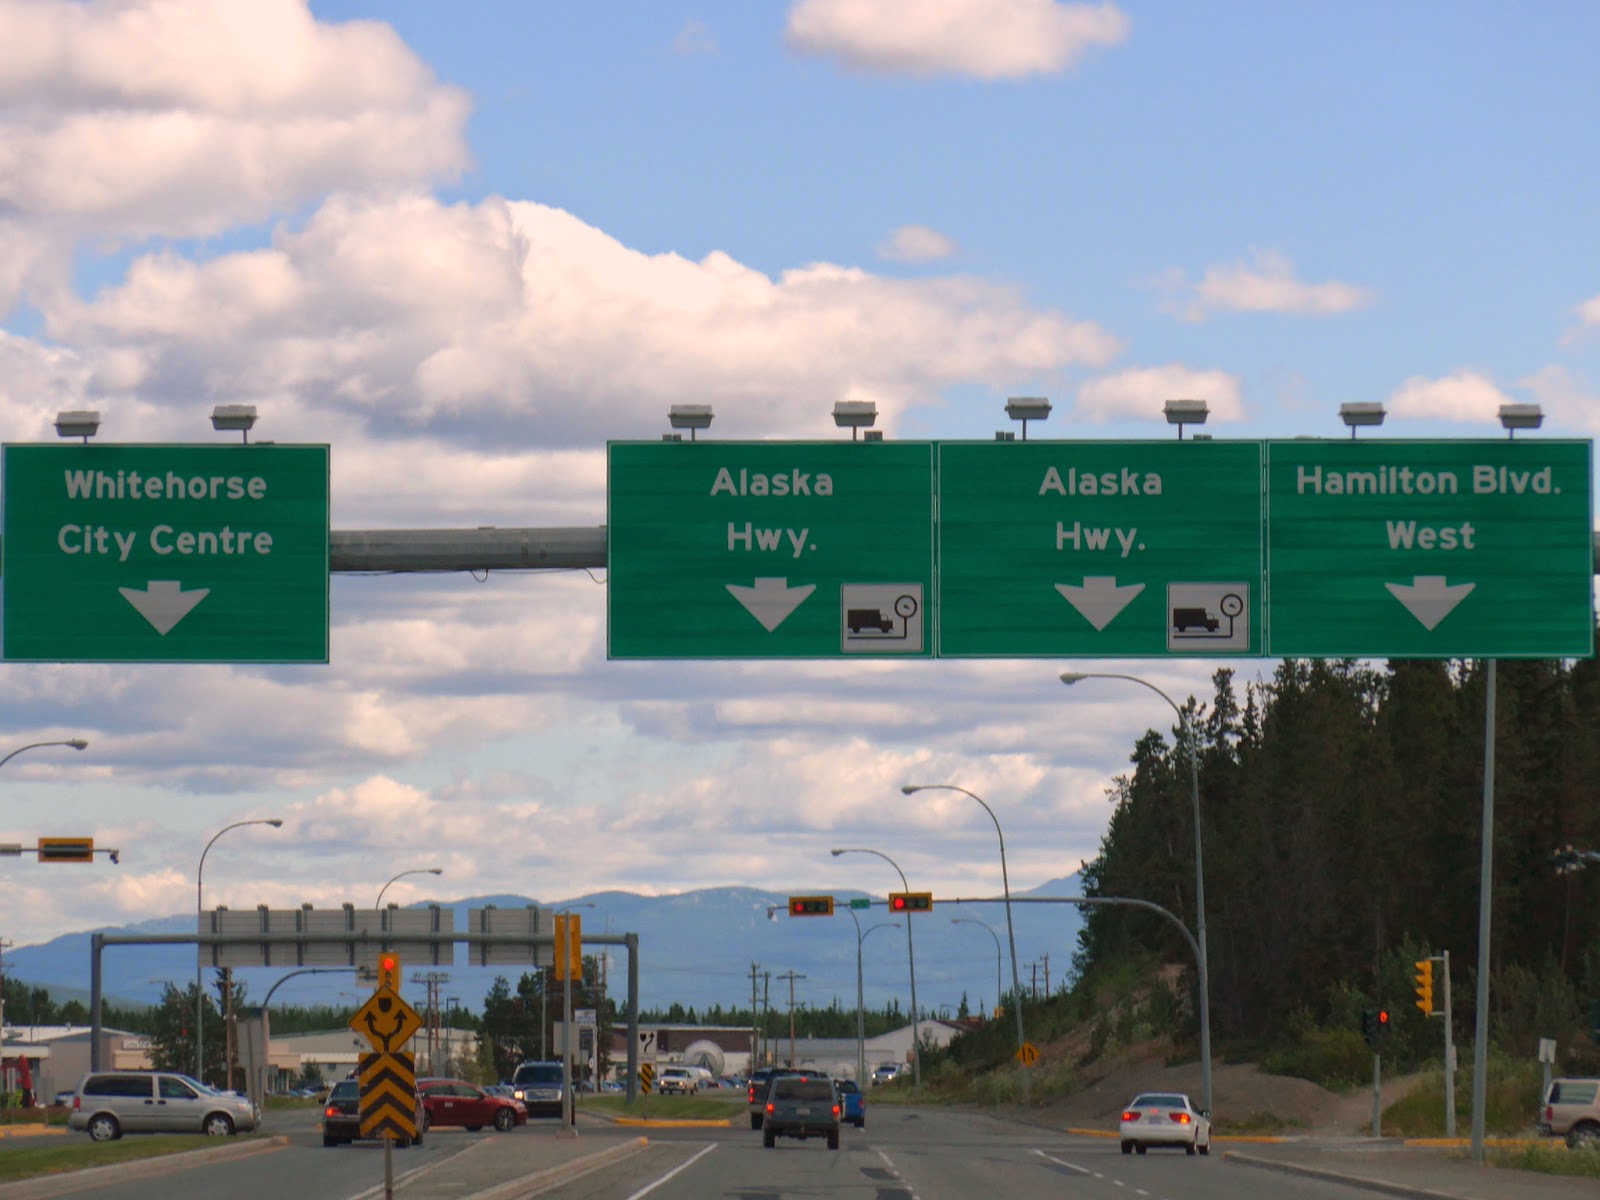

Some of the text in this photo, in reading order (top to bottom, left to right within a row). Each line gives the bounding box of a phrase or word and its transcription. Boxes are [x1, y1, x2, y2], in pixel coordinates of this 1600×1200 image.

[65, 470, 267, 499] Whitehorse
[710, 467, 833, 495] Alaska
[1039, 467, 1163, 495] Alaska
[1298, 466, 1561, 494] Hamilton Blvd.
[58, 524, 273, 561] City Centre
[728, 522, 817, 557] Hwy.
[1056, 522, 1146, 557] Hwy.
[1387, 521, 1475, 549] West
